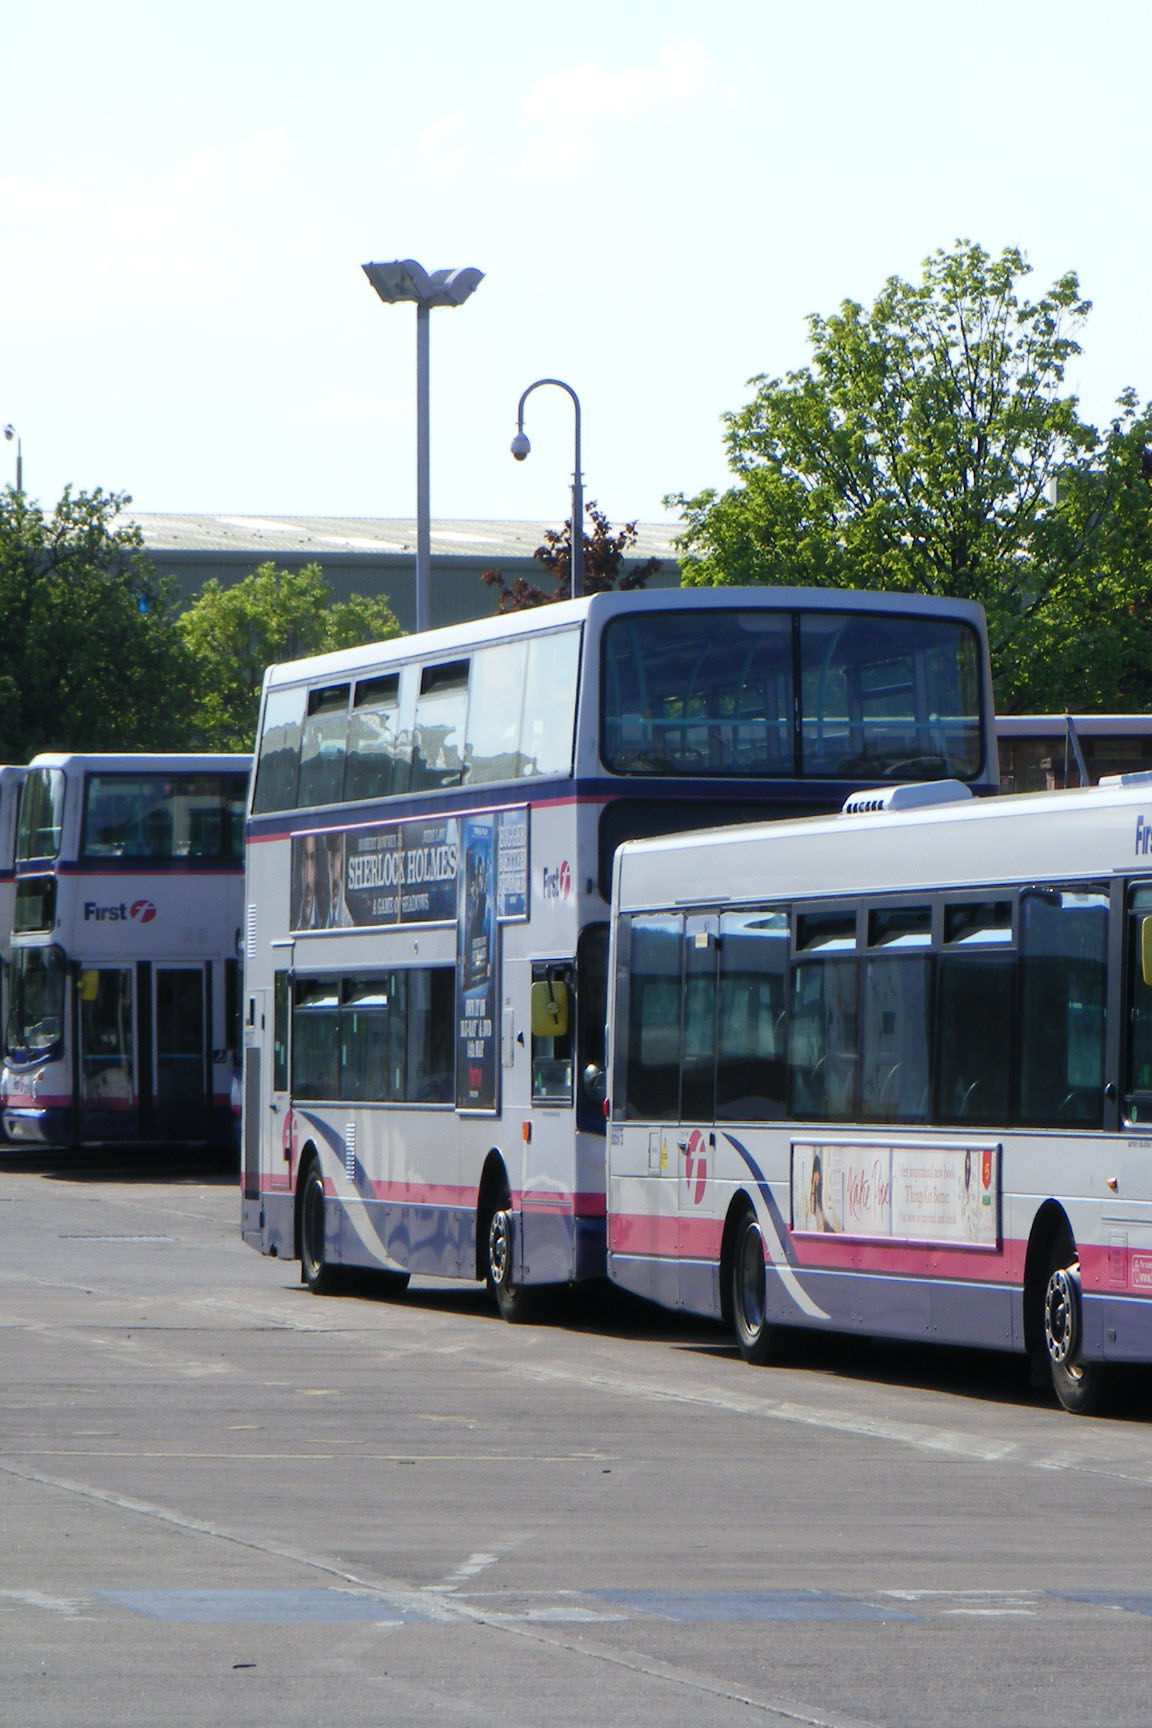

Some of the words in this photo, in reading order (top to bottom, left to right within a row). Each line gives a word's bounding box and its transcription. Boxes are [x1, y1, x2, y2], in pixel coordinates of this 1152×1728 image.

[349, 851, 405, 890] SHERLOCK
[406, 845, 457, 884] HOLMES
[543, 866, 559, 899] First
[84, 902, 127, 921] First
[372, 899, 377, 914] A
[377, 896, 393, 914] GAME
[402, 893, 430, 914] SHADOWS
